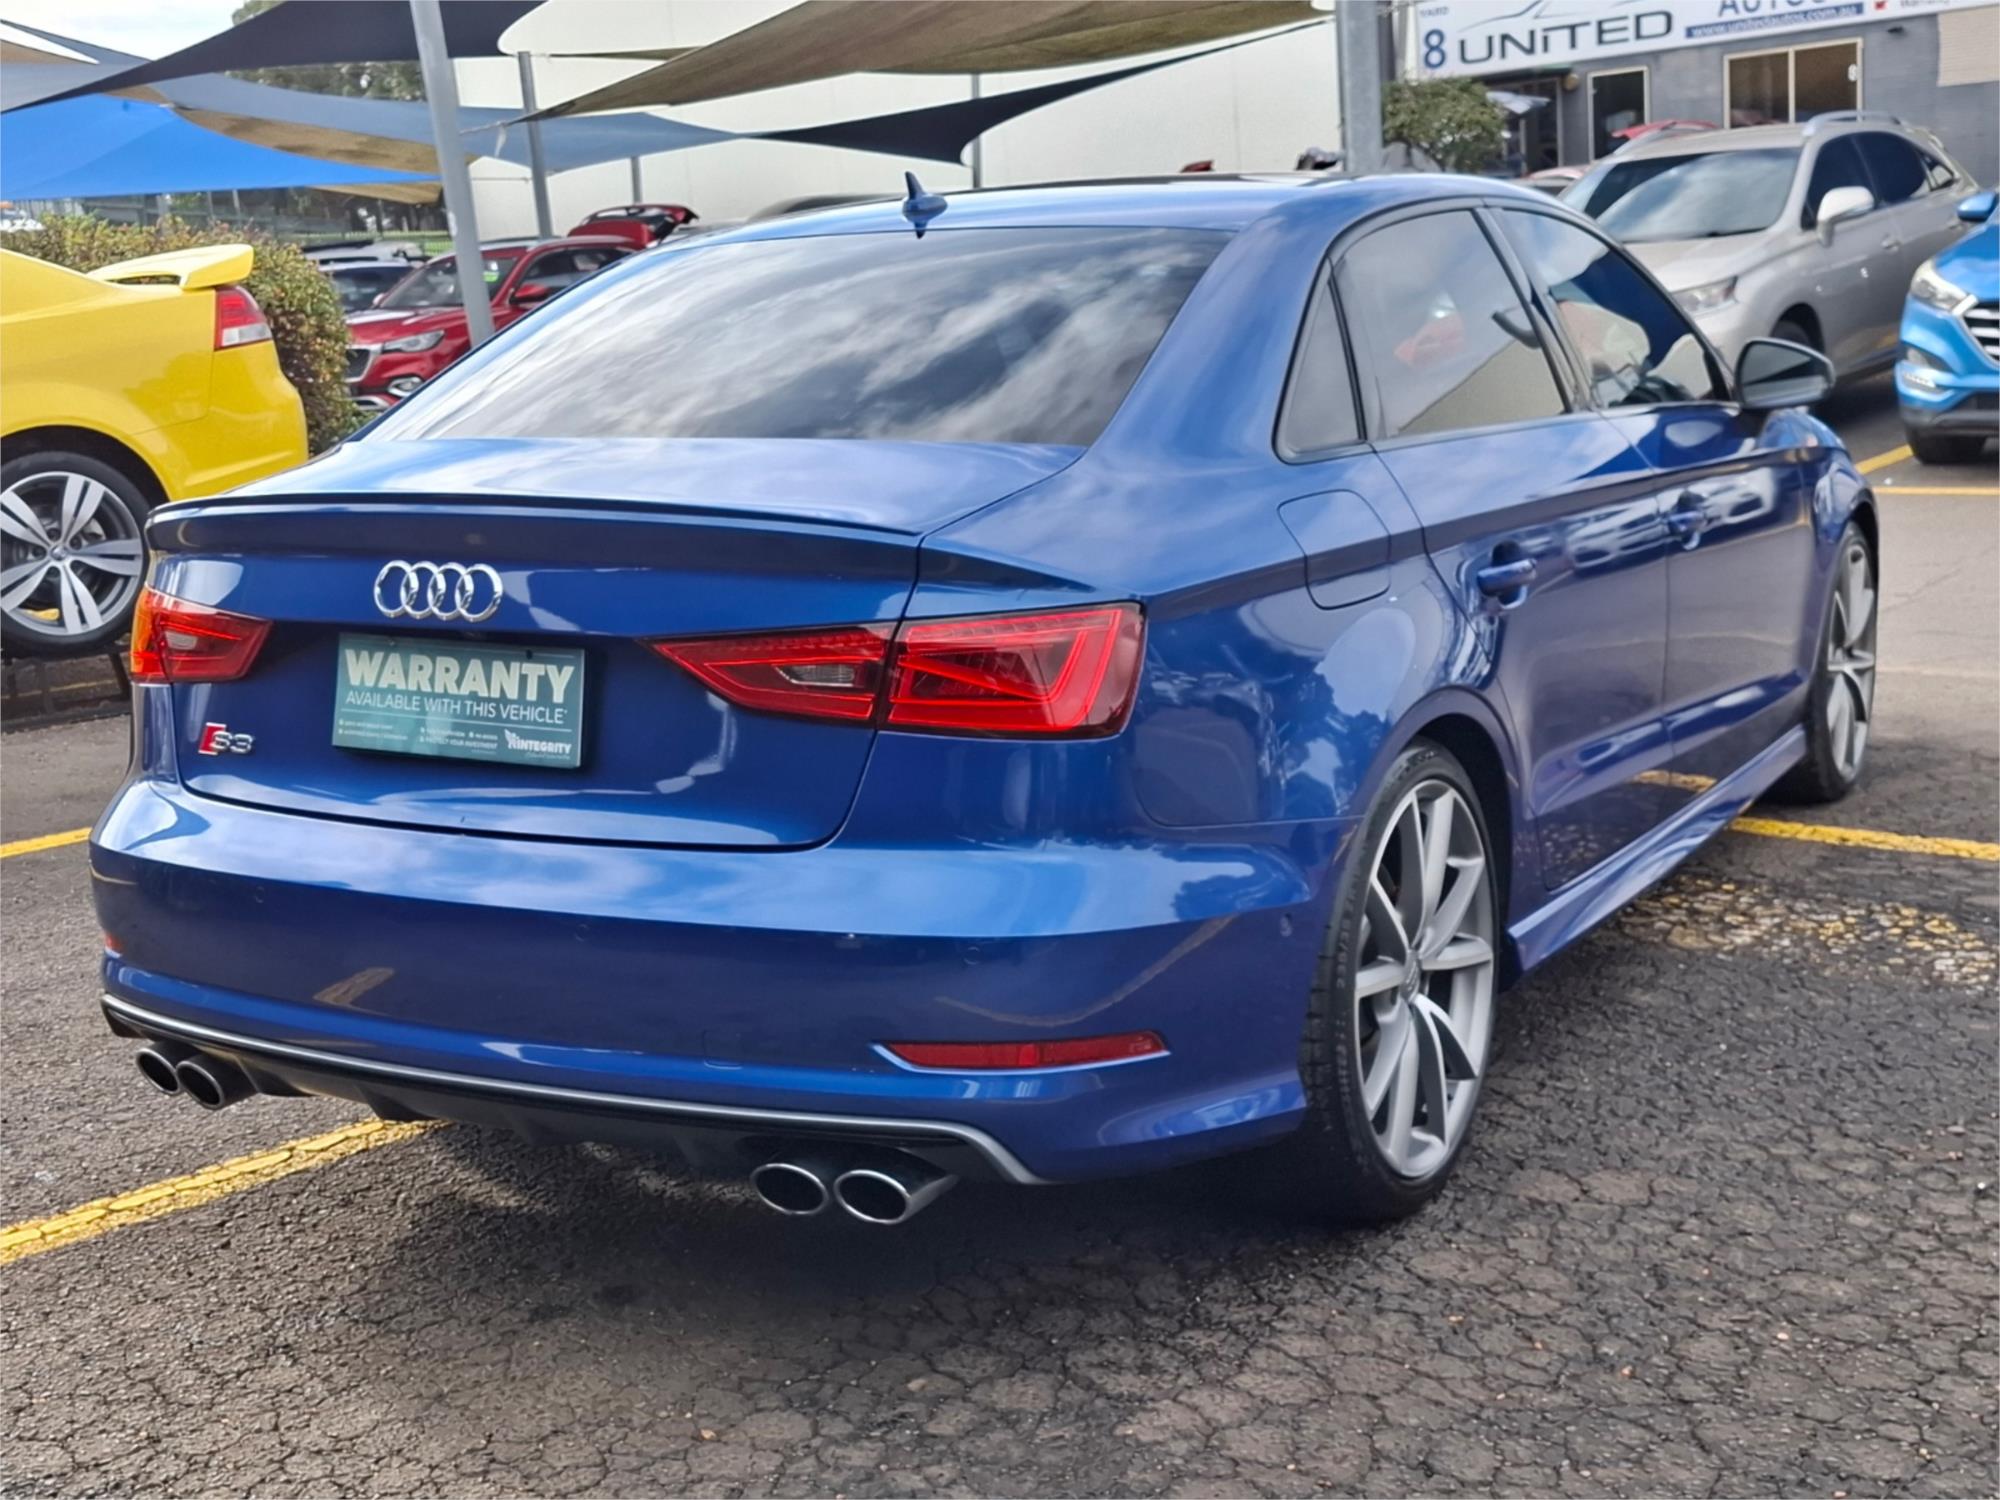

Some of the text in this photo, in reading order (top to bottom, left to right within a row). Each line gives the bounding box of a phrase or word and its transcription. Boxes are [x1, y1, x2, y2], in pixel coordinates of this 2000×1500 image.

[1424, 28, 1446, 69] 8
[345, 649, 575, 704] WARRANTY
[346, 690, 421, 711] AVAILABLE
[423, 697, 460, 714] WITH
[464, 700, 497, 718] THIS
